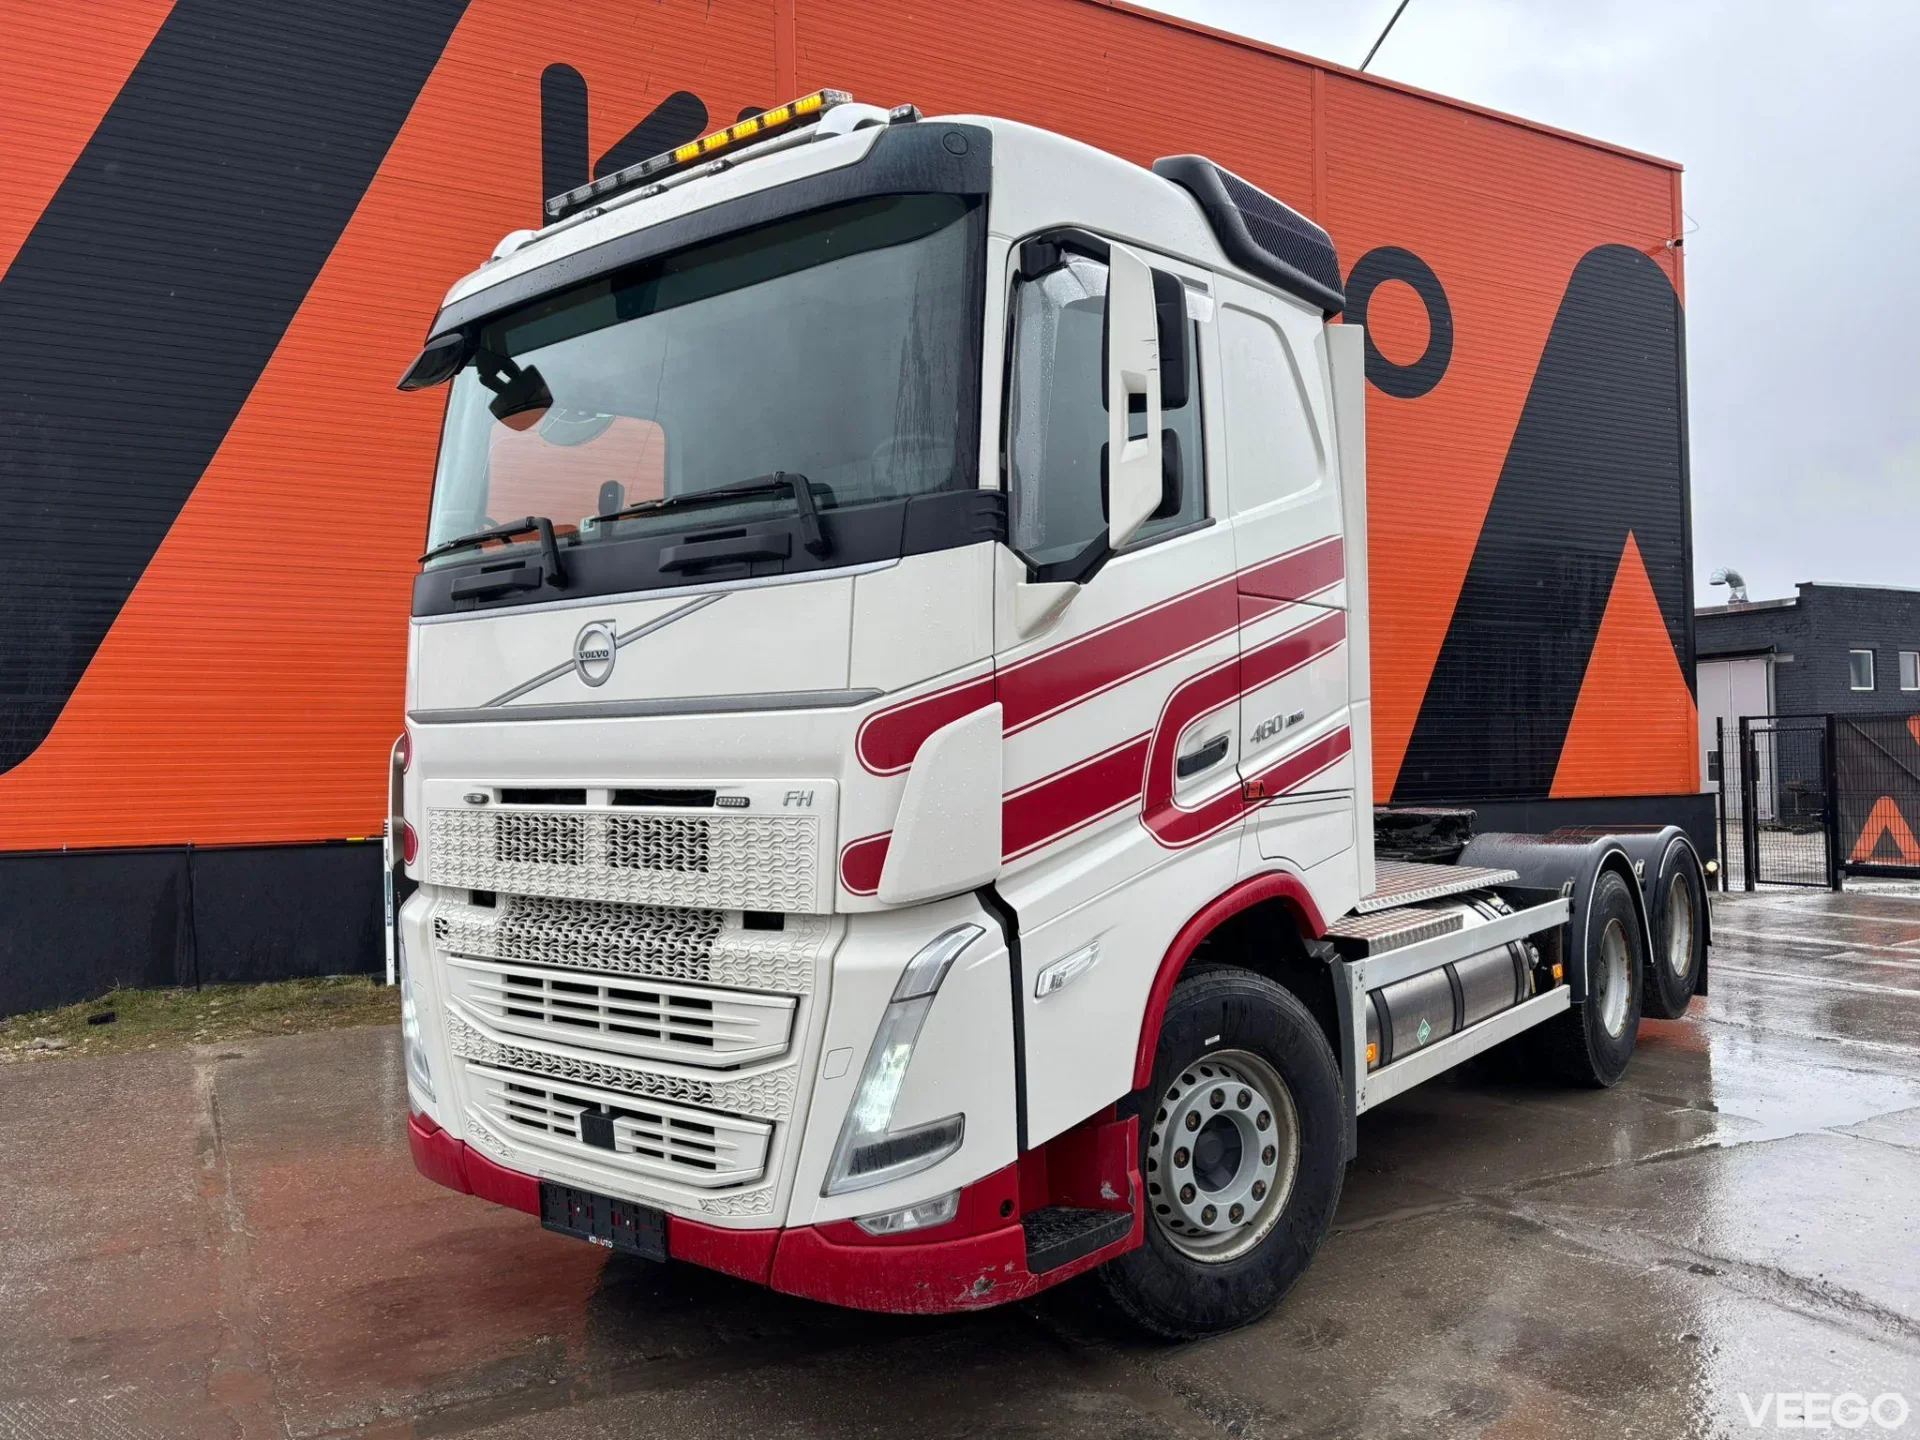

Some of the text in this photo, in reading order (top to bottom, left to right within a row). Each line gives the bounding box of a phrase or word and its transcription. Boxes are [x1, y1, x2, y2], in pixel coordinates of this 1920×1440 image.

[579, 650, 609, 659] VOLVO
[1250, 713, 1283, 744] 460
[783, 790, 814, 807] FH
